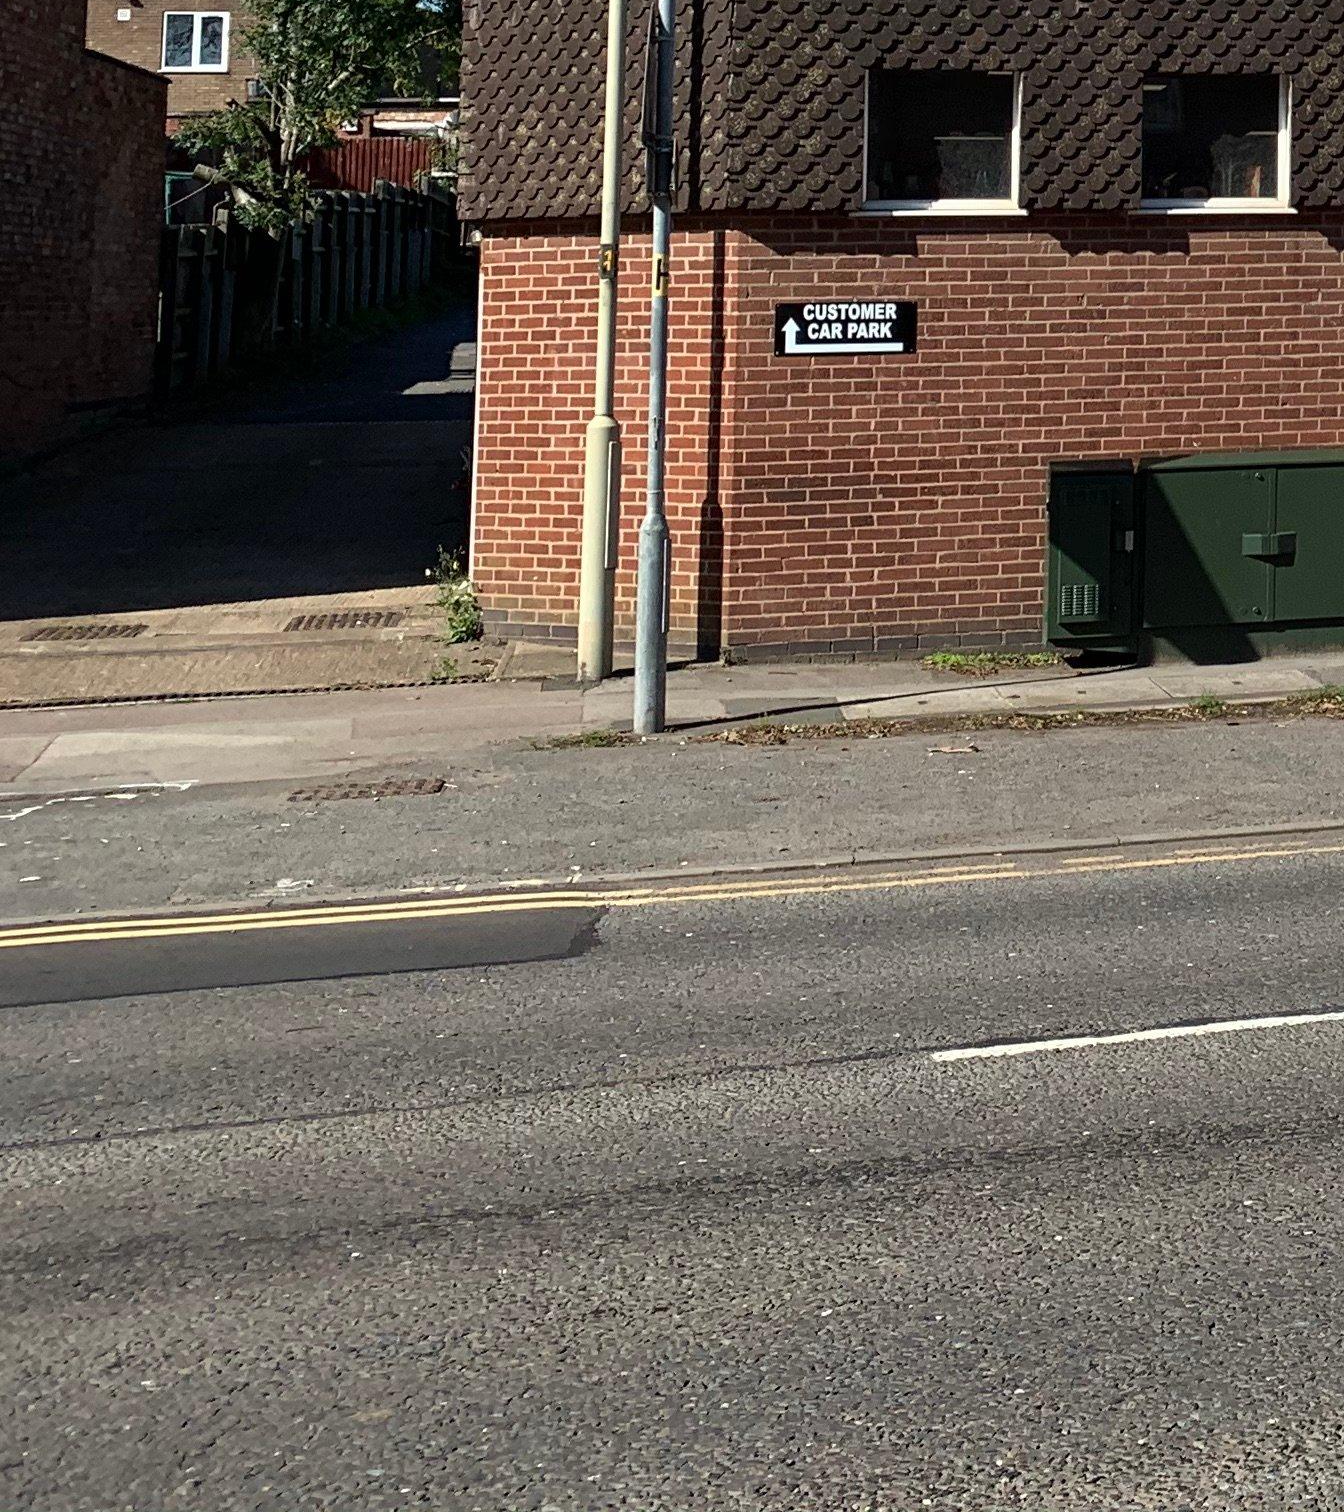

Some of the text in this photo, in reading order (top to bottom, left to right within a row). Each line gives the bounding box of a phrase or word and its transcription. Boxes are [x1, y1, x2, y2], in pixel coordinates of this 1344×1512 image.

[803, 303, 897, 321] CUSTOMER
[807, 321, 893, 340] CAR PARK
